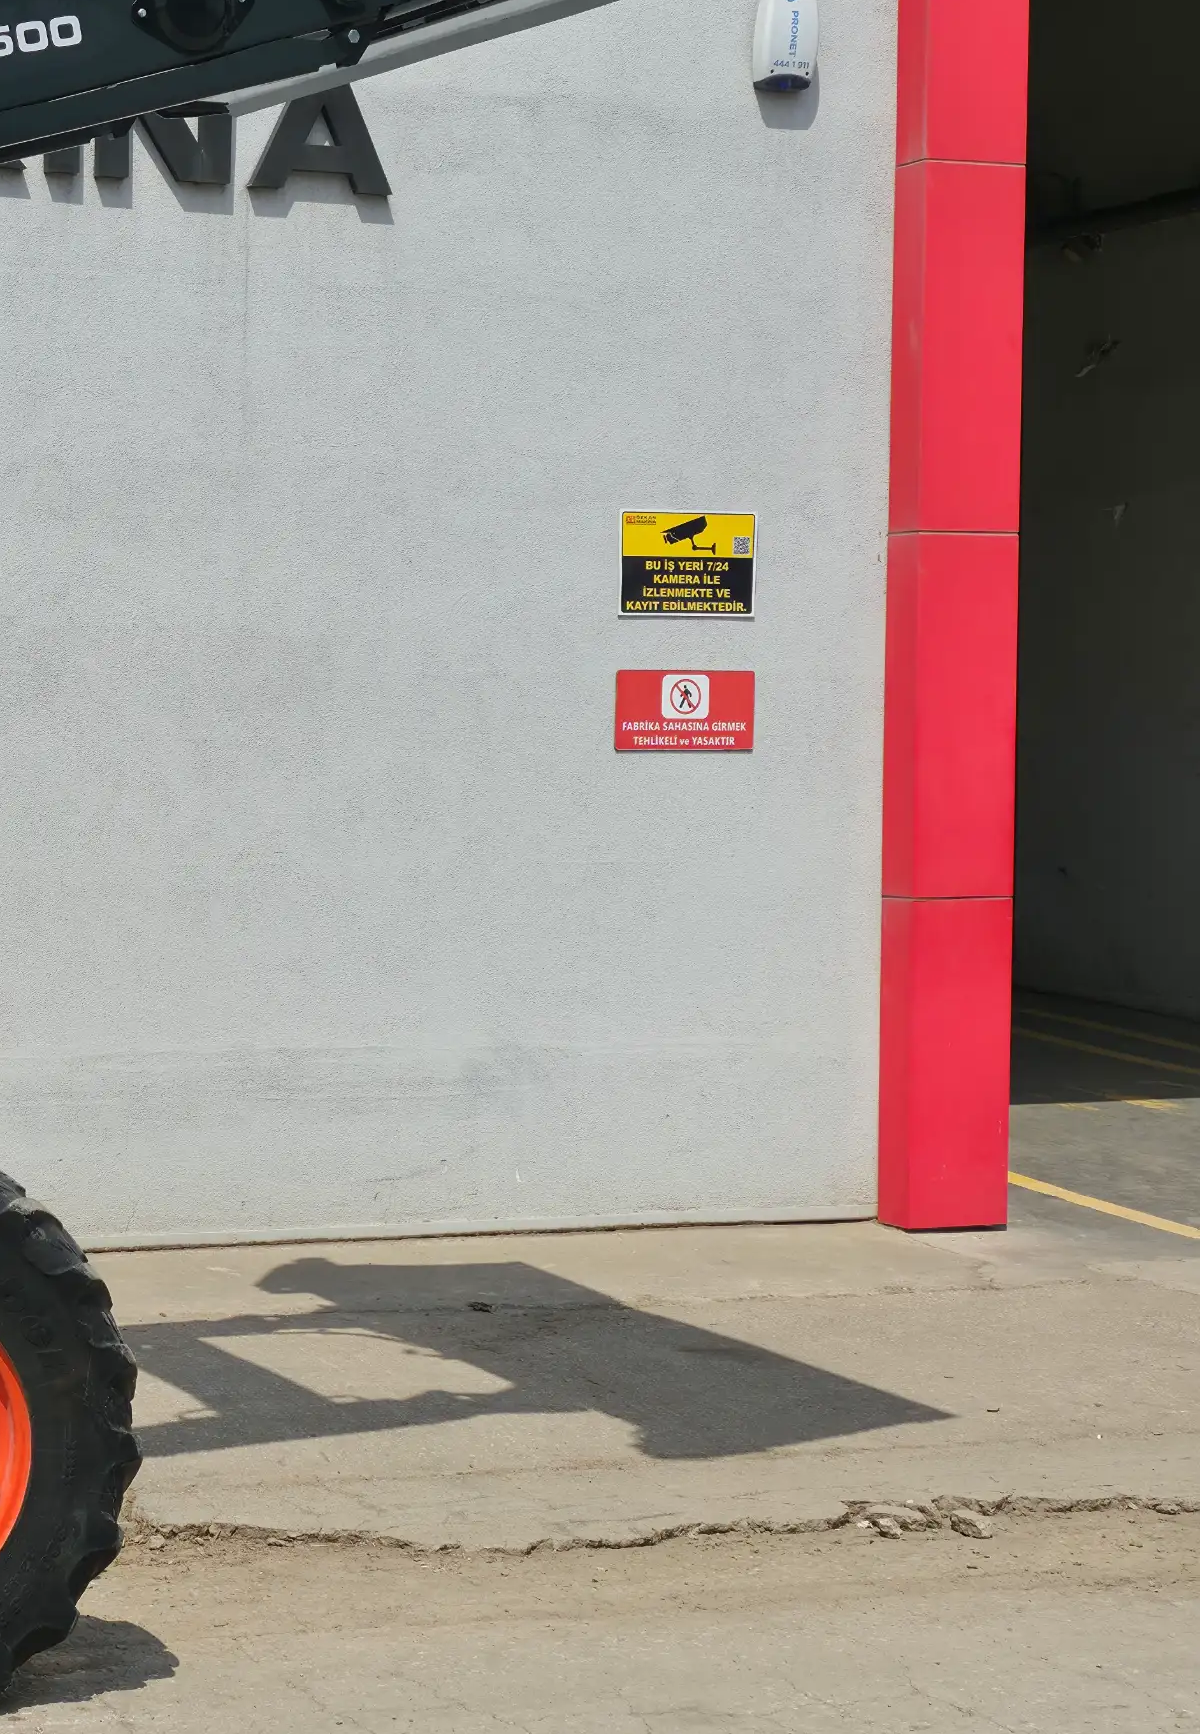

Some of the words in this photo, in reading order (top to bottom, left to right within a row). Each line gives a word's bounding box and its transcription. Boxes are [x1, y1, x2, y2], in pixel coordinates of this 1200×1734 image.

[789, 10, 799, 57] PRONET
[773, 60, 790, 68] 444
[798, 61, 810, 69] 911
[645, 560, 661, 570] BU
[664, 559, 675, 572] İŞ
[678, 560, 704, 571] YERİ
[706, 562, 729, 571] 7/24
[653, 574, 700, 584] KAMERA
[703, 574, 720, 584] İLE
[642, 586, 713, 598] İZLENMEKTE
[716, 589, 731, 598] VE
[626, 601, 660, 611] KAYIT
[662, 600, 747, 612] EDİLMEKTEDİR.
[622, 720, 660, 731] FABRİKA
[662, 721, 709, 731] SAHASINA
[711, 720, 746, 731] GİRMEK
[633, 735, 677, 745] TEHLİKELİ
[692, 737, 735, 745] YASAKTIR
